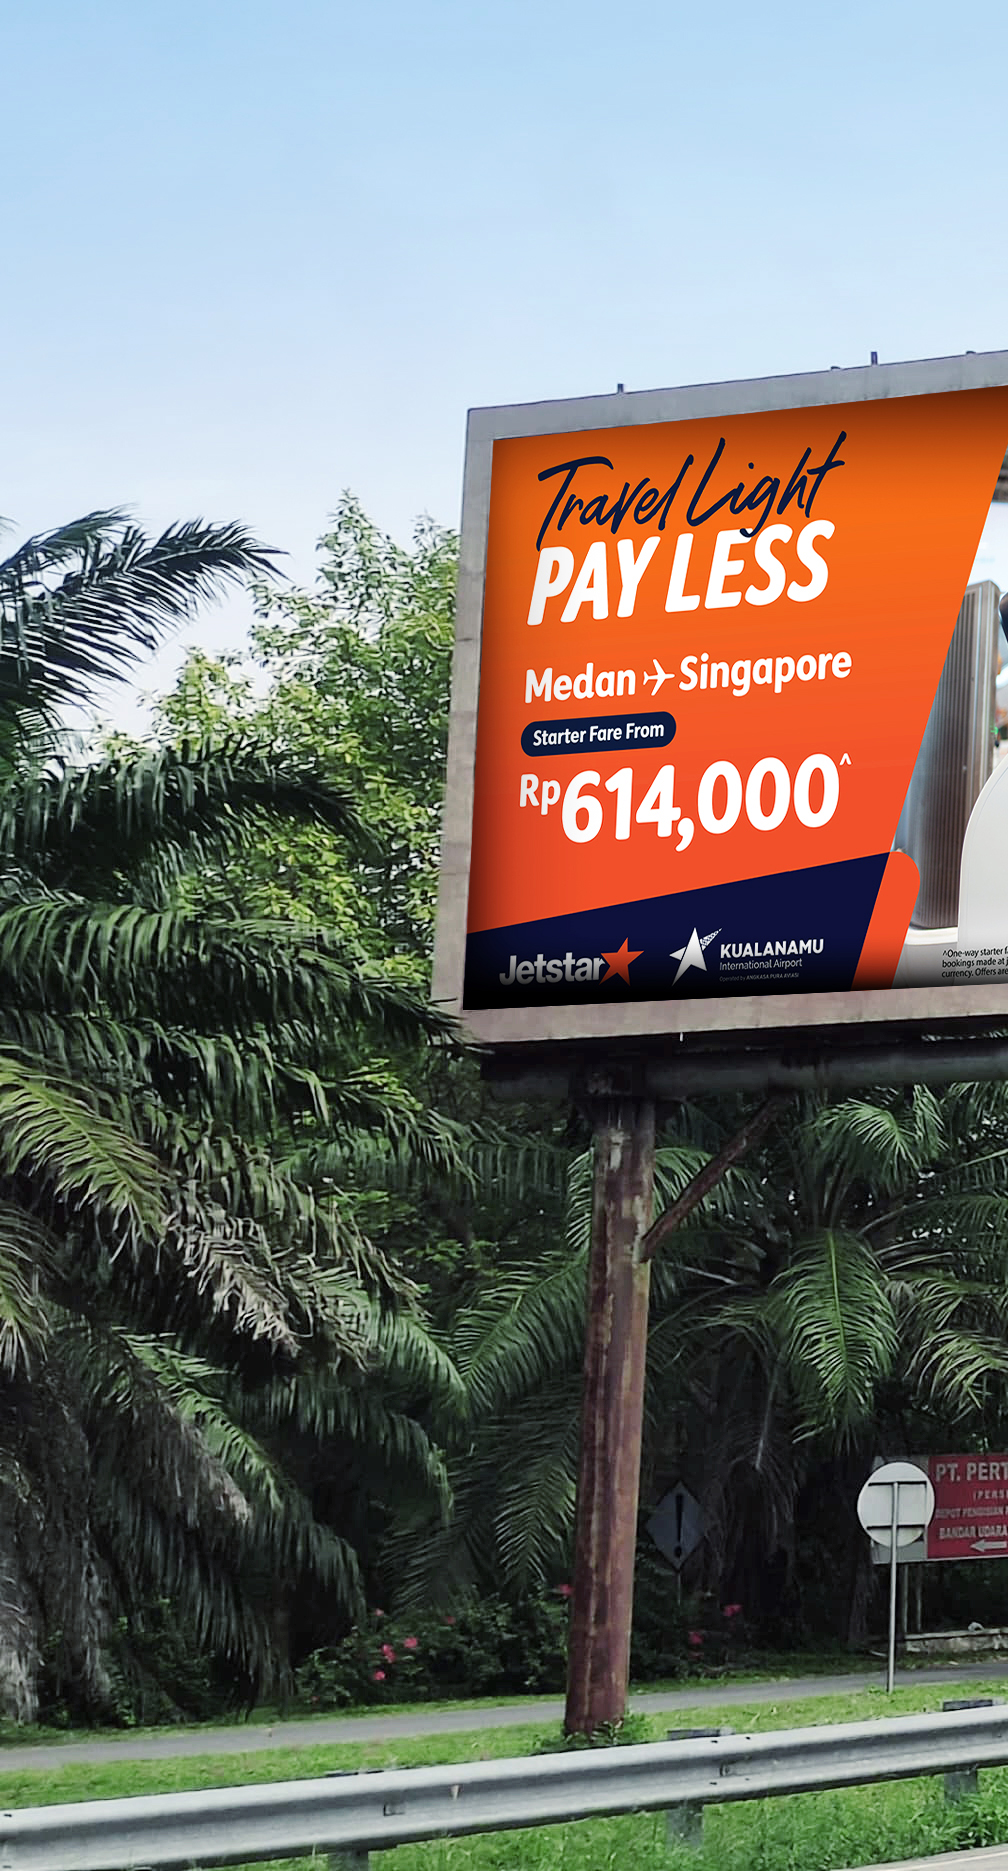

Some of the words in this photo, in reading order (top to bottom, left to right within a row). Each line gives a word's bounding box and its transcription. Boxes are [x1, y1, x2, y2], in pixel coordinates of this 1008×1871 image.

[536, 454, 694, 551] Travel
[686, 430, 847, 538] Light
[526, 535, 661, 627] PAY
[664, 519, 836, 613] LESS
[524, 662, 636, 704] Medan
[679, 650, 853, 697] Singapore
[532, 724, 587, 746] Starter
[589, 722, 622, 742] Fare
[625, 721, 665, 740] From
[720, 938, 824, 959] KUALANAMU
[942, 948, 979, 958] ^One-way
[980, 947, 1004, 956] starter
[499, 952, 606, 985] Jetstar
[719, 959, 772, 971] International
[774, 958, 803, 969] Airport
[941, 969, 974, 978] currency.
[975, 968, 996, 976] Offers
[942, 959, 975, 969] bookings
[976, 957, 997, 966] made
[935, 1463, 960, 1482] PT.
[939, 1525, 976, 1540] BANDAR
[978, 1524, 1008, 1538] UDARA
